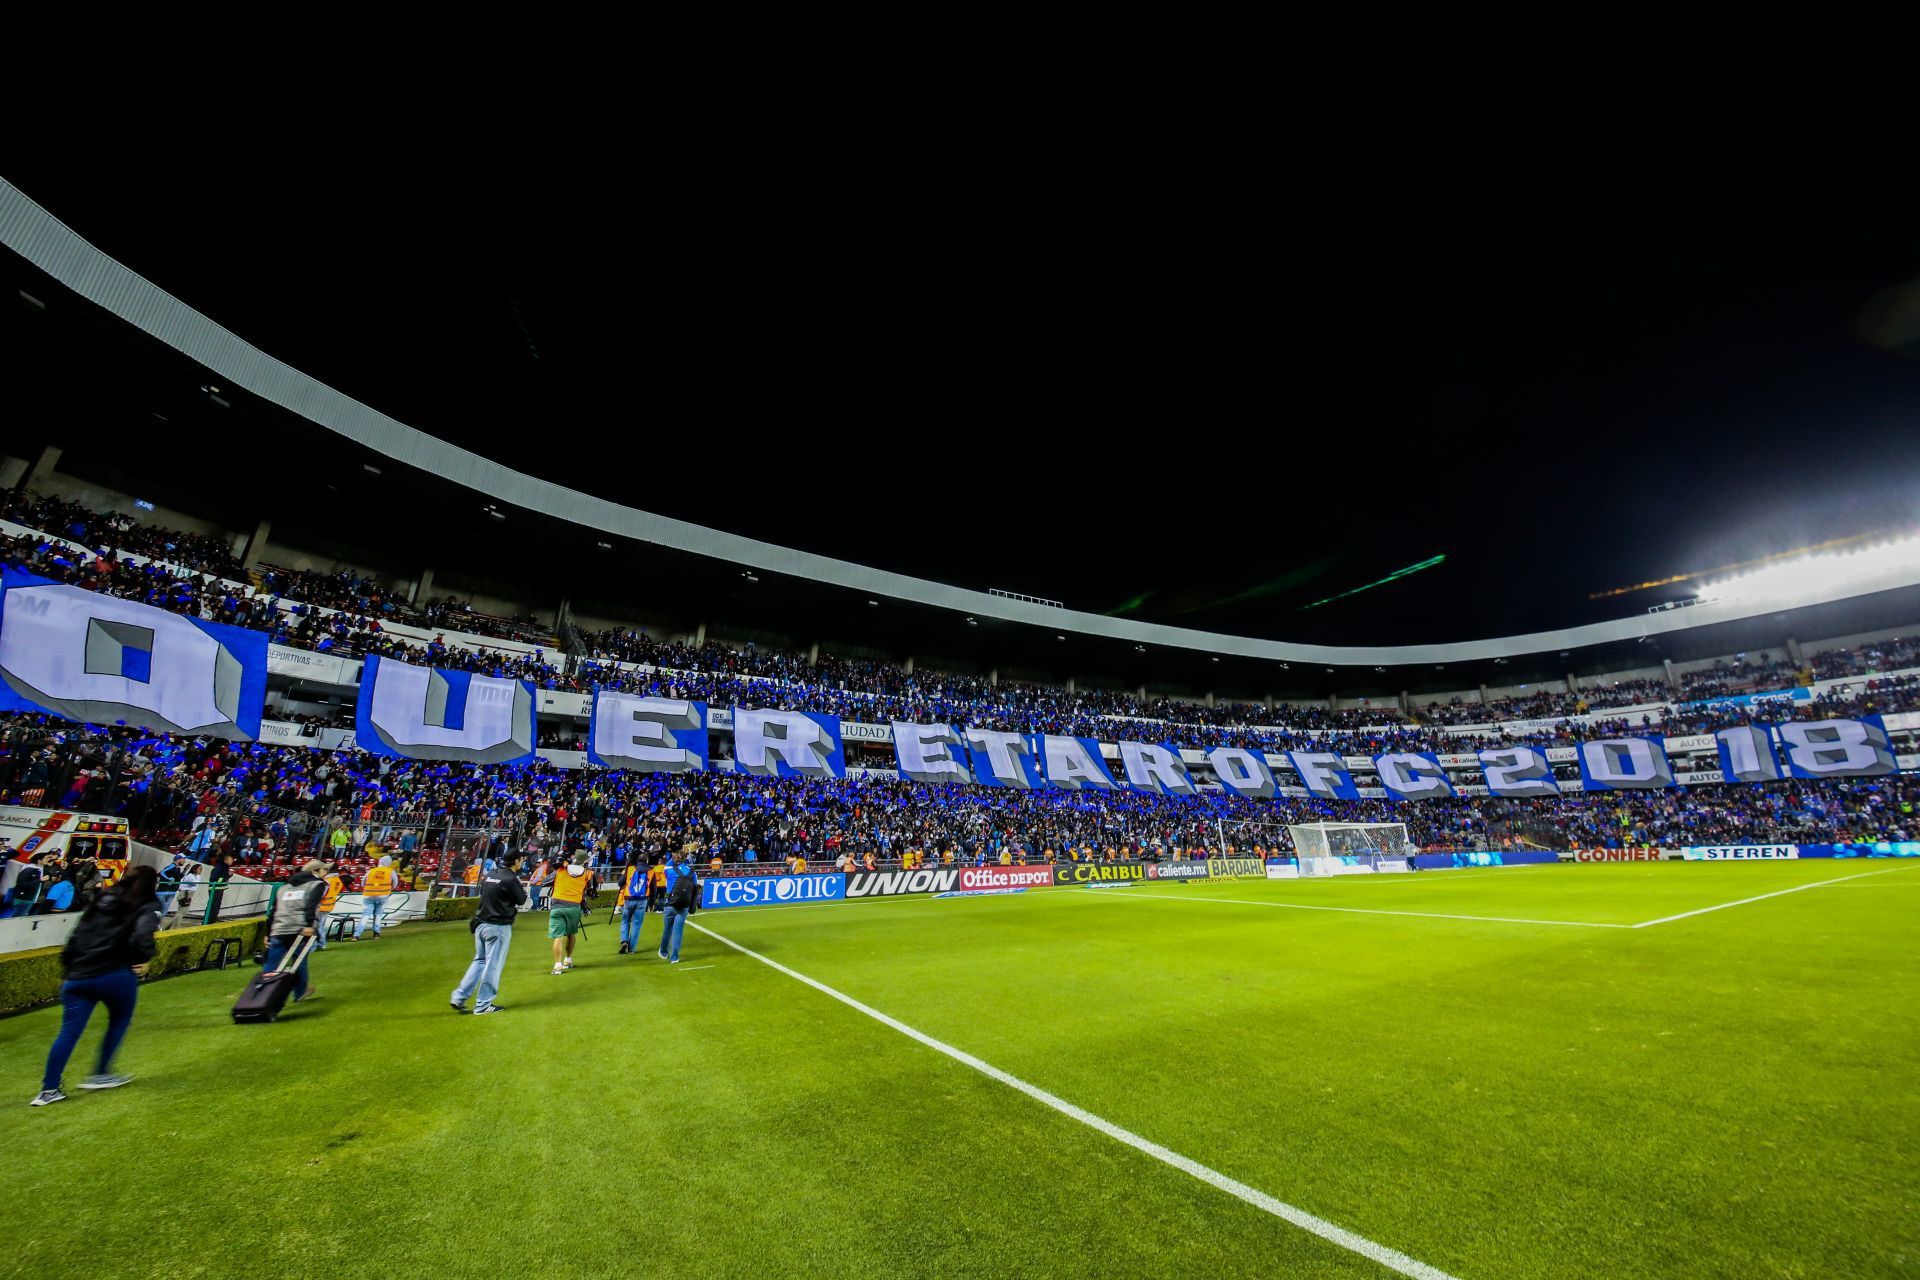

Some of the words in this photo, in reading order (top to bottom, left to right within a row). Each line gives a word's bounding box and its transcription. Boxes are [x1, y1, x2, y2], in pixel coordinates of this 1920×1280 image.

[840, 722, 885, 738] CIUDAD
[1707, 847, 1789, 859] STEREN
[1074, 865, 1144, 882] CARIBU
[1157, 863, 1207, 877] caliente.mx
[1211, 859, 1265, 877] BARDAHL
[846, 869, 958, 897] UNION
[963, 869, 1008, 887] Office
[1009, 871, 1049, 885] DEPOT
